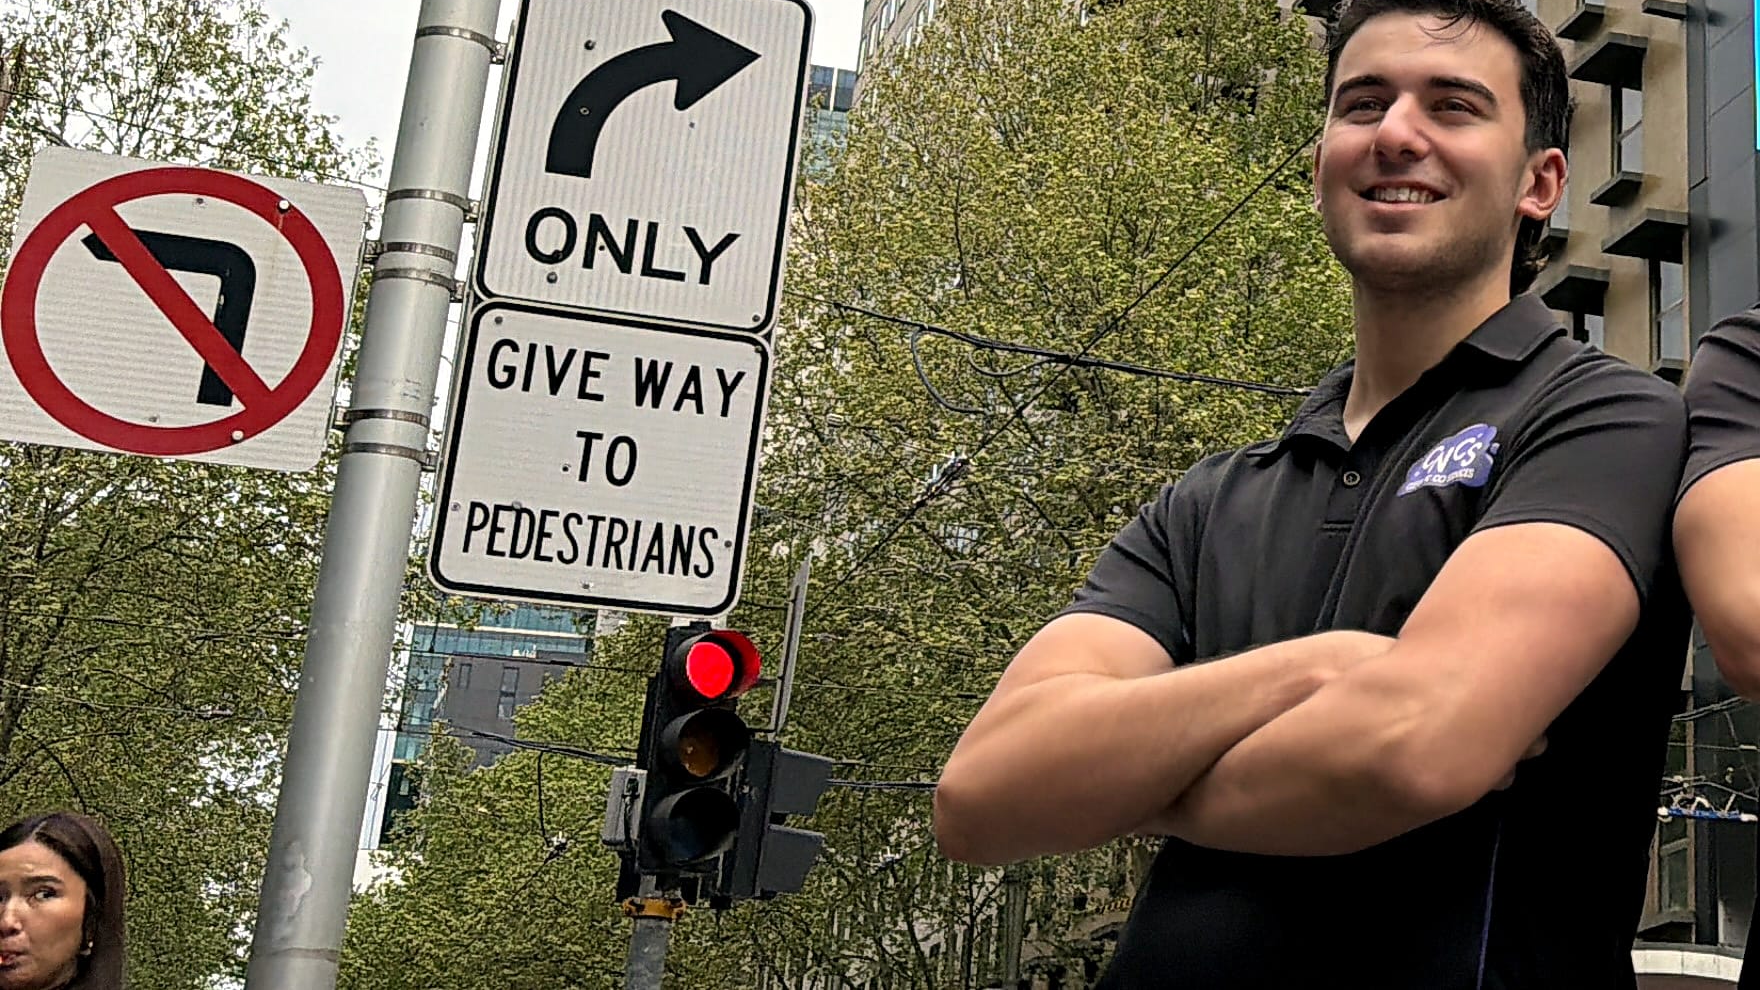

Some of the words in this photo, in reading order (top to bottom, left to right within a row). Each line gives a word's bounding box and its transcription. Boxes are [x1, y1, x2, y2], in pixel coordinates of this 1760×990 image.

[525, 207, 741, 286] ONLY
[486, 338, 610, 402] GIVE
[634, 356, 747, 418] WAY
[575, 430, 638, 487] TO
[461, 500, 719, 579] PEDESTRIANS
